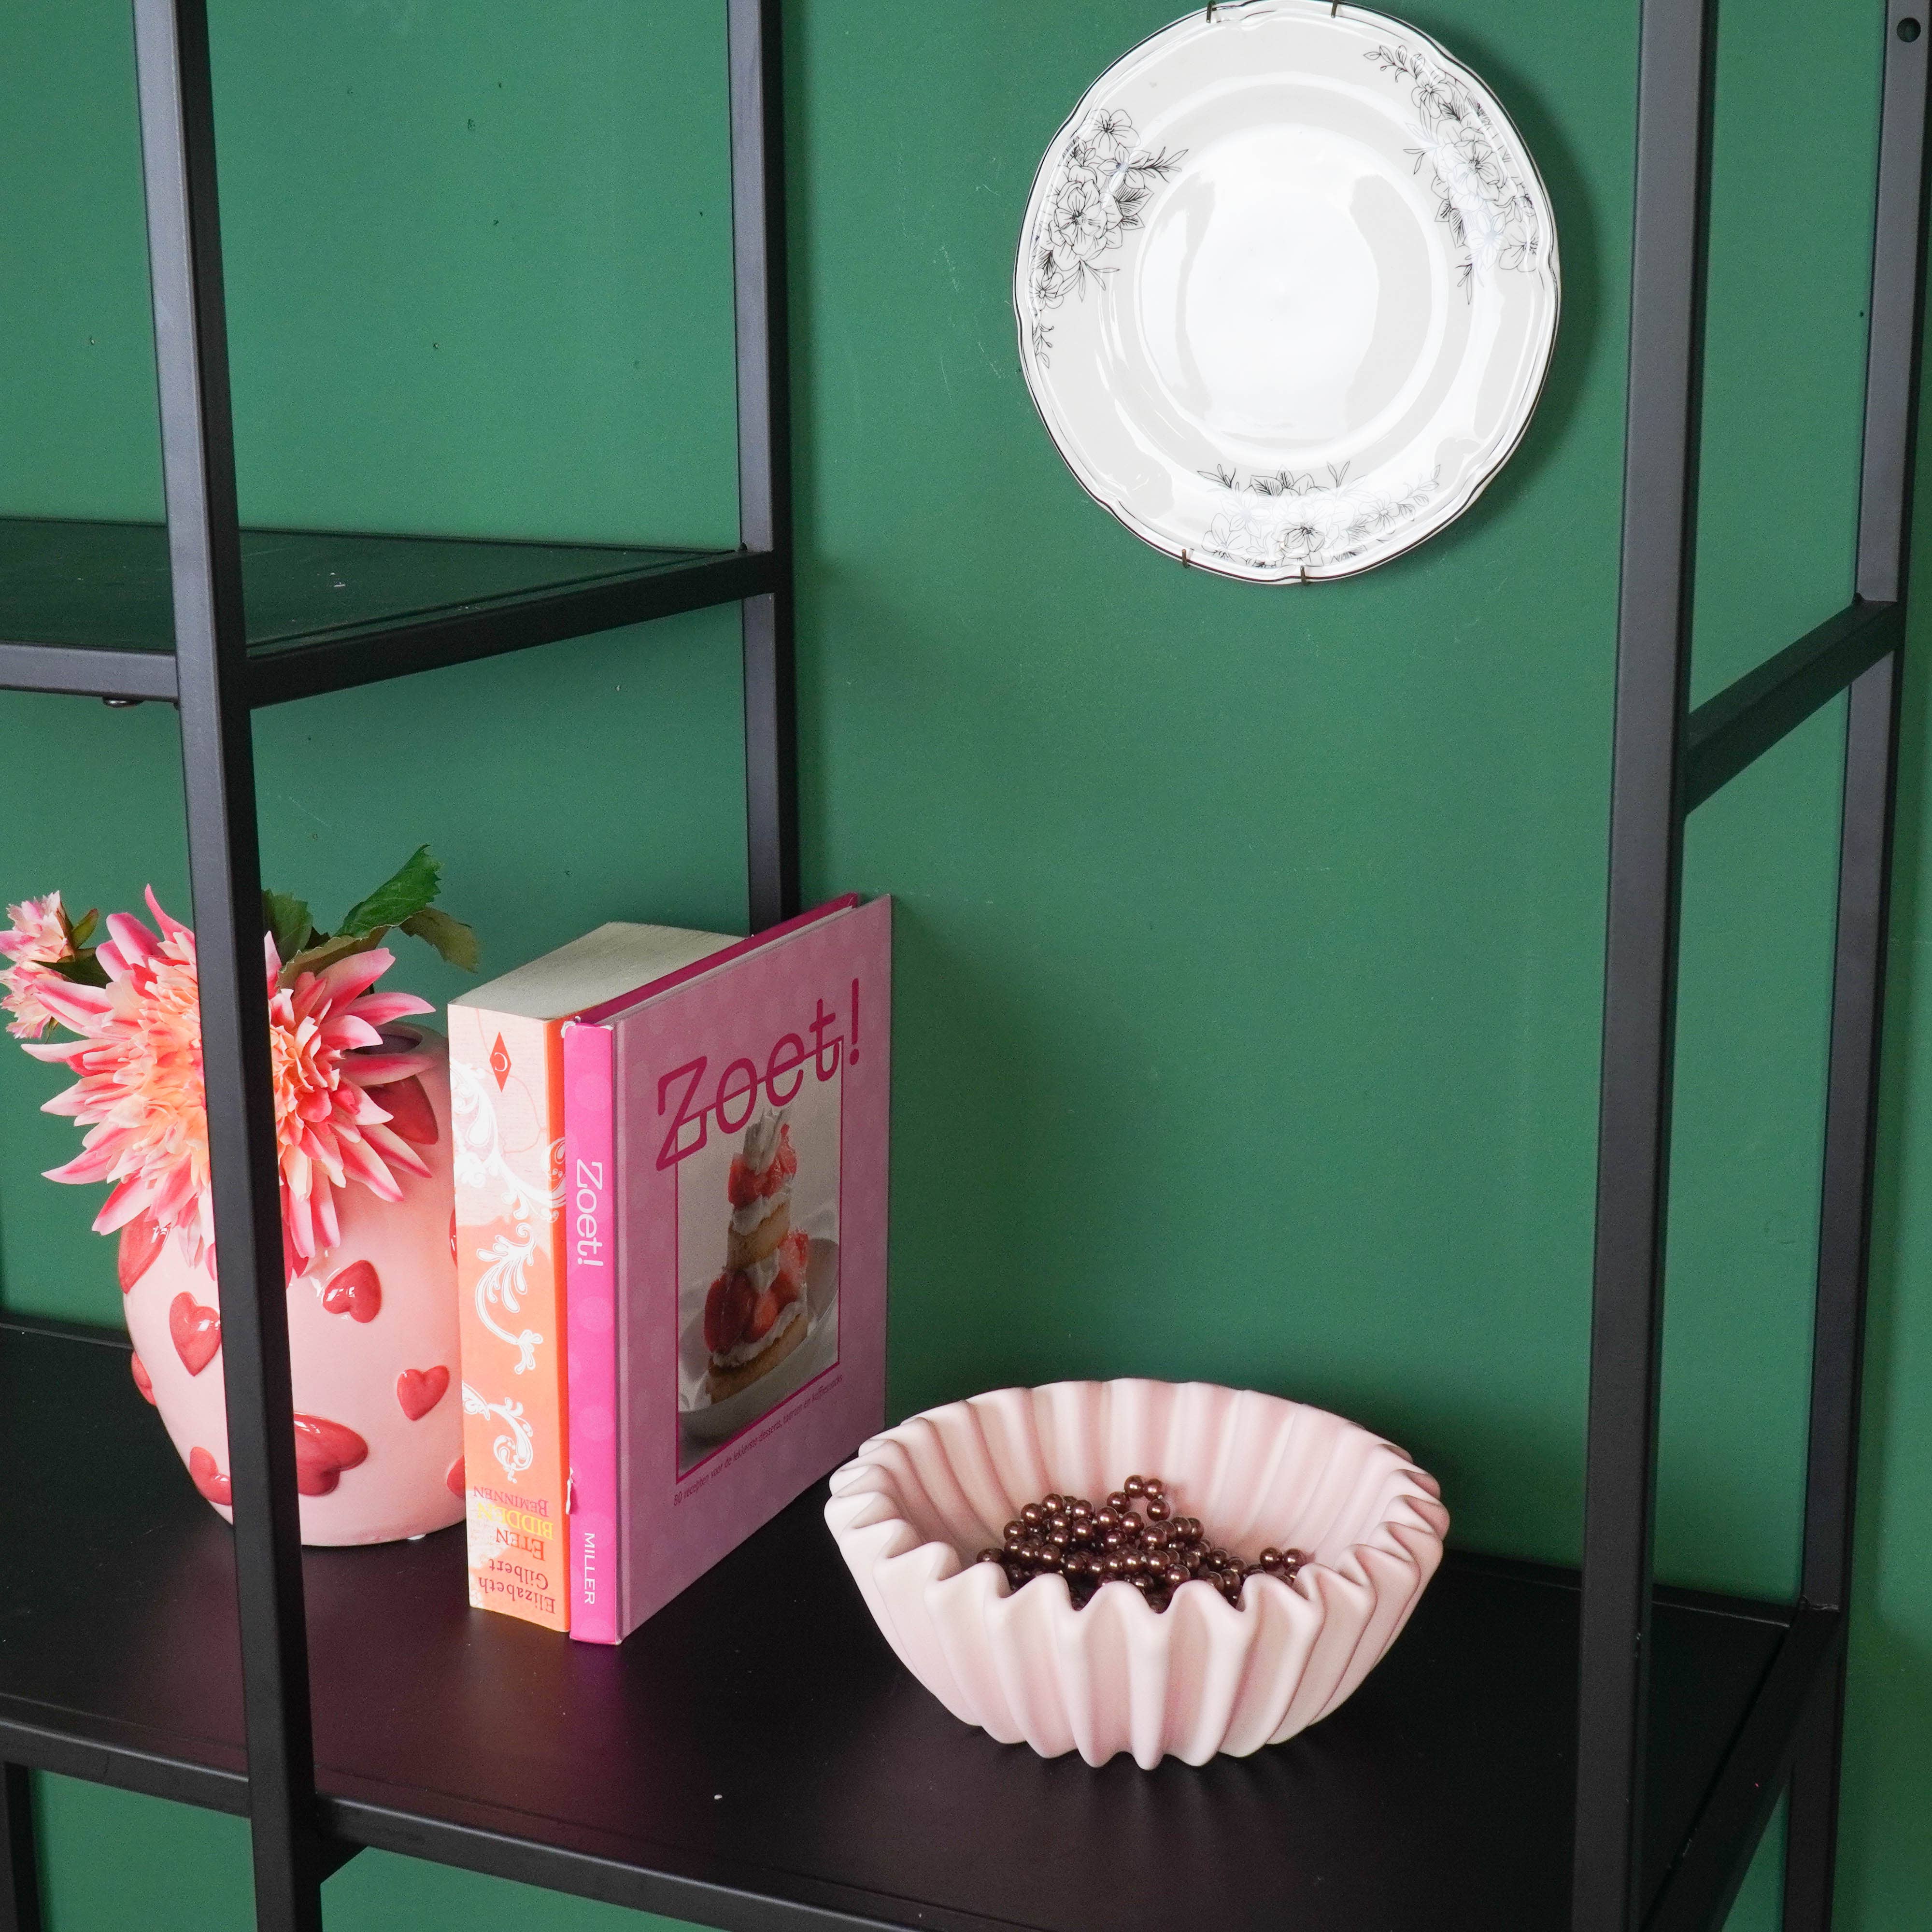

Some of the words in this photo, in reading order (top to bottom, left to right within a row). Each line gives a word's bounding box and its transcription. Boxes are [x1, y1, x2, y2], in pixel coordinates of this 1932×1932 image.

[655, 978, 859, 1171] Zoet!
[576, 1159, 604, 1267] Zoet!
[684, 1474, 709, 1499] recepten
[710, 1463, 723, 1478] voor
[724, 1456, 732, 1468] de
[733, 1437, 758, 1461] lekkerste
[804, 1398, 811, 1408] en
[477, 1502, 554, 1540] BIDDEN
[495, 1528, 545, 1562] ETEN
[478, 1577, 556, 1615] Elizabeth
[488, 1559, 549, 1591] Gilbert
[584, 1532, 596, 1605] MILLER
